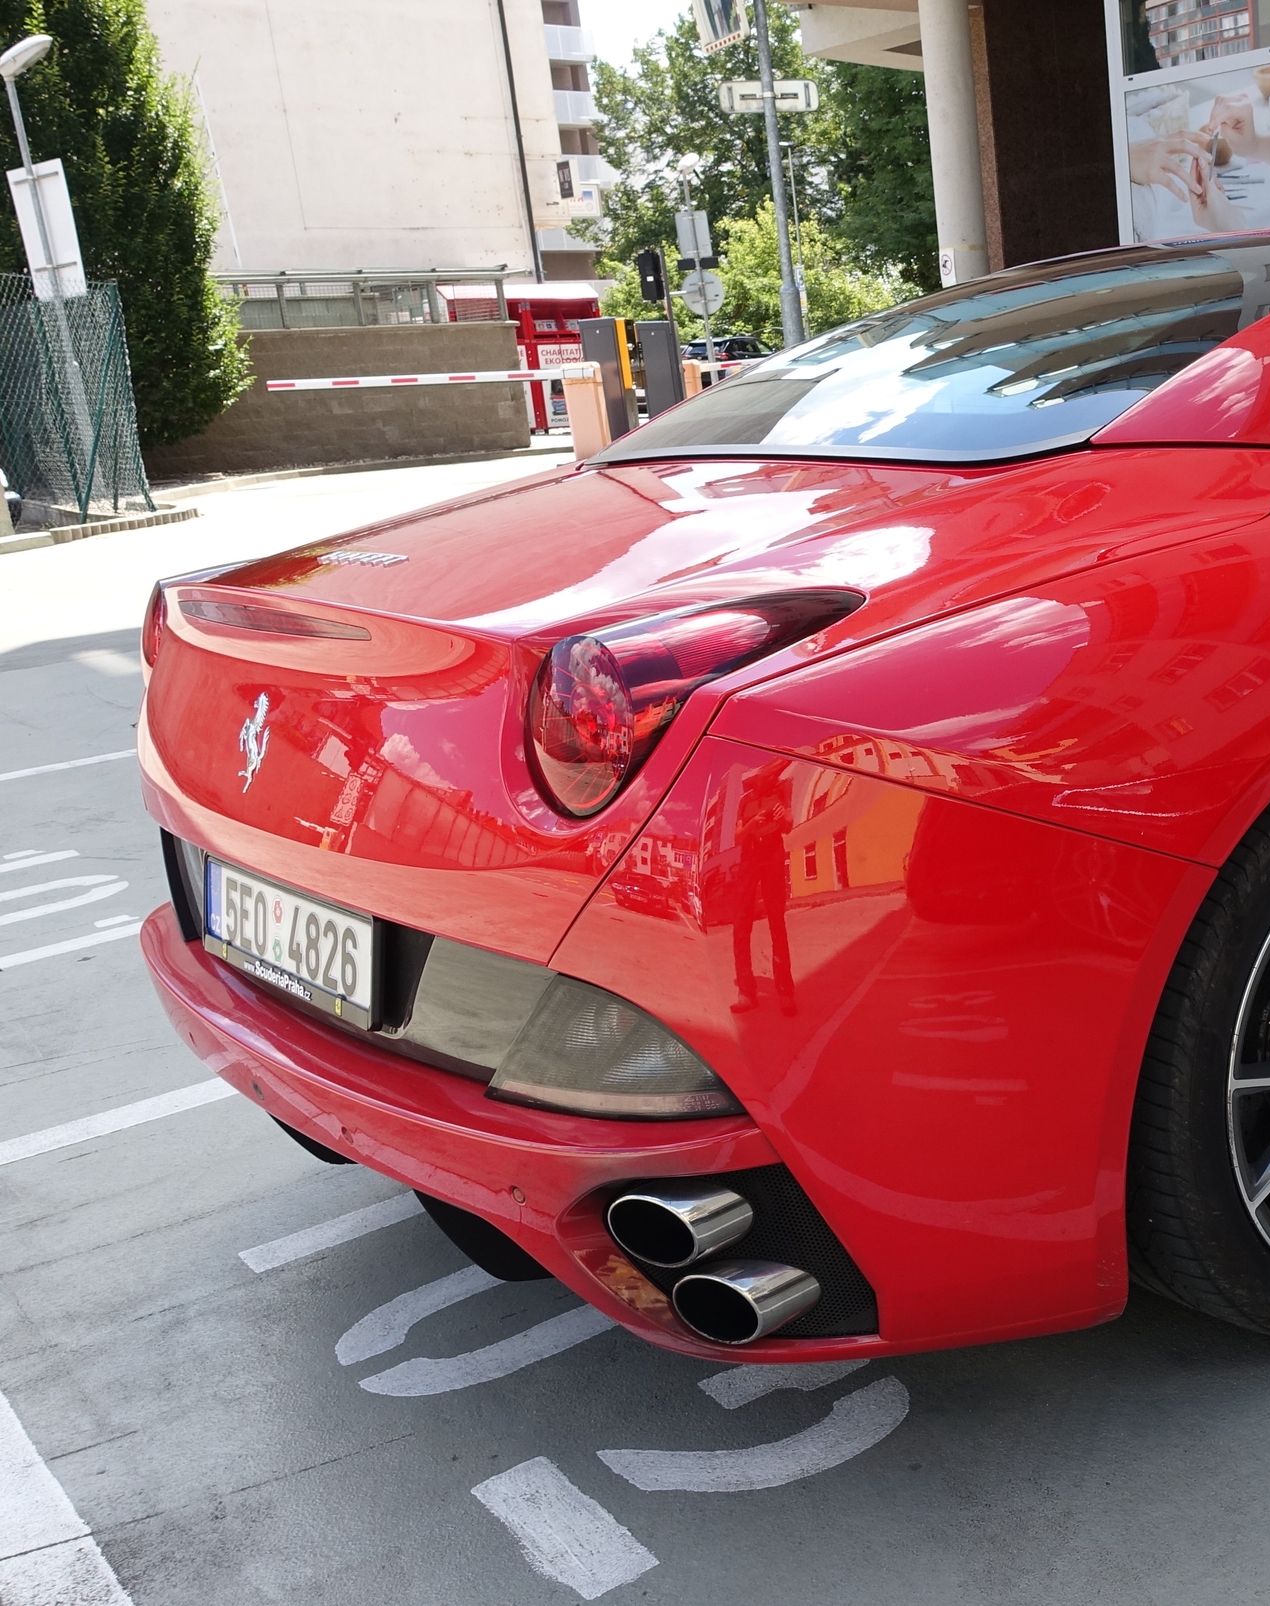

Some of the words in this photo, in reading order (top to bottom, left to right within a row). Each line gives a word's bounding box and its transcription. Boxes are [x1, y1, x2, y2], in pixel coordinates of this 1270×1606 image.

[210, 912, 222, 934] CZ
[288, 905, 359, 998] 4826
[243, 960, 312, 1001] www.ScuderiaPraha.cz
